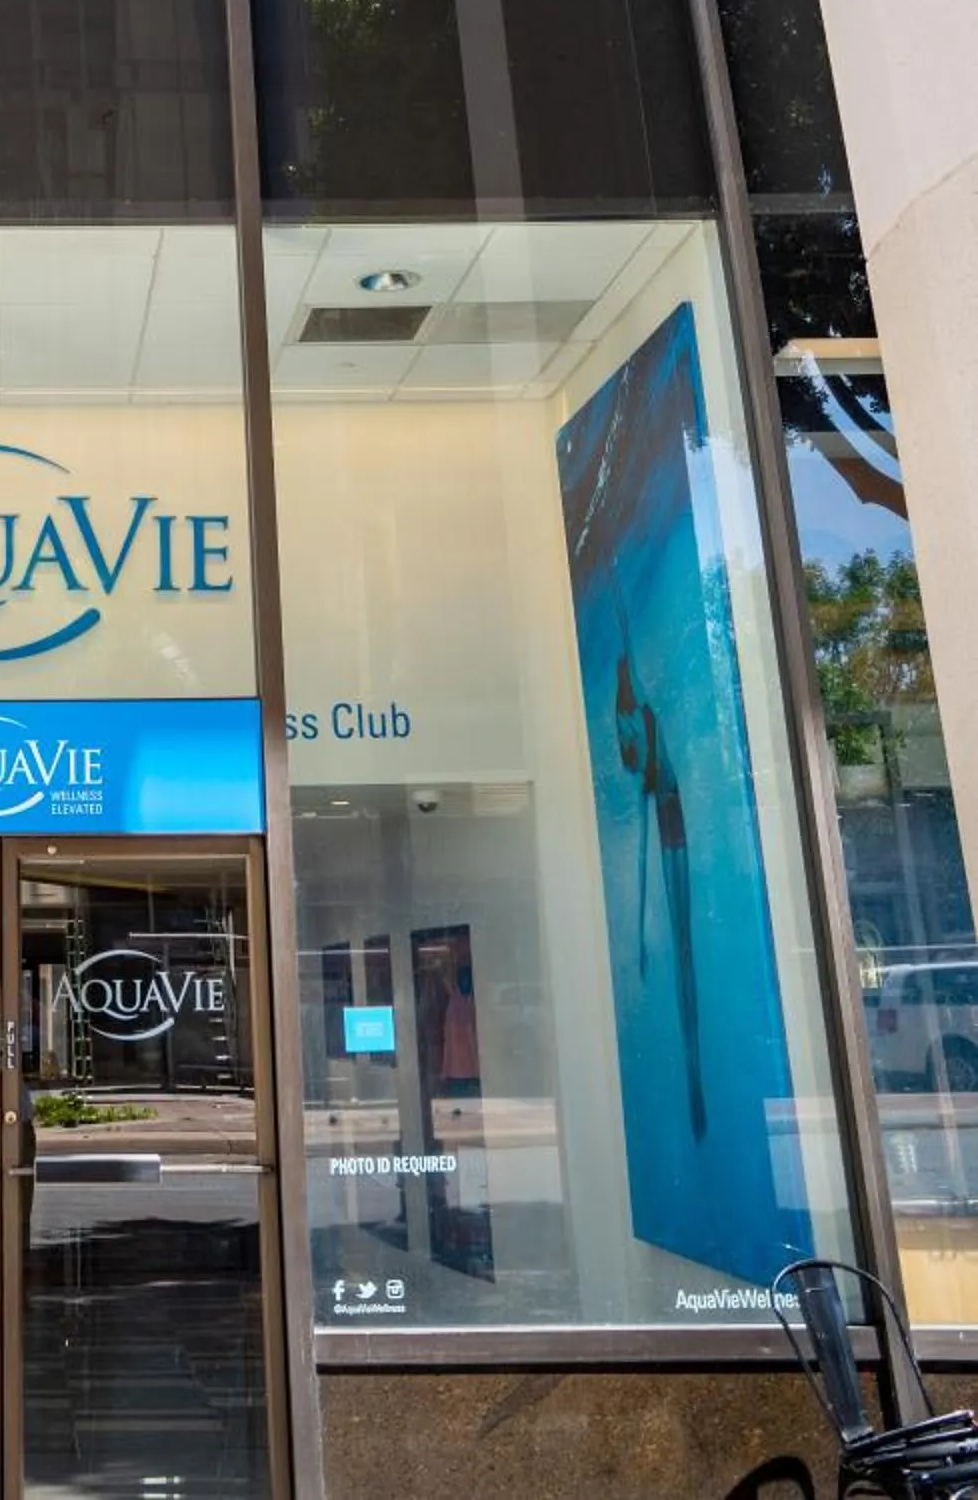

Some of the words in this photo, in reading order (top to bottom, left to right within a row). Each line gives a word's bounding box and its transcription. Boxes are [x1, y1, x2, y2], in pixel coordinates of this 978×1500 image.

[332, 701, 411, 739] Club
[51, 790, 103, 801] WELLNESS
[51, 803, 103, 815] ELEVATED
[329, 1156, 375, 1175] PHOTO
[377, 1156, 391, 1173] ID
[393, 1155, 457, 1177] REQUIRED
